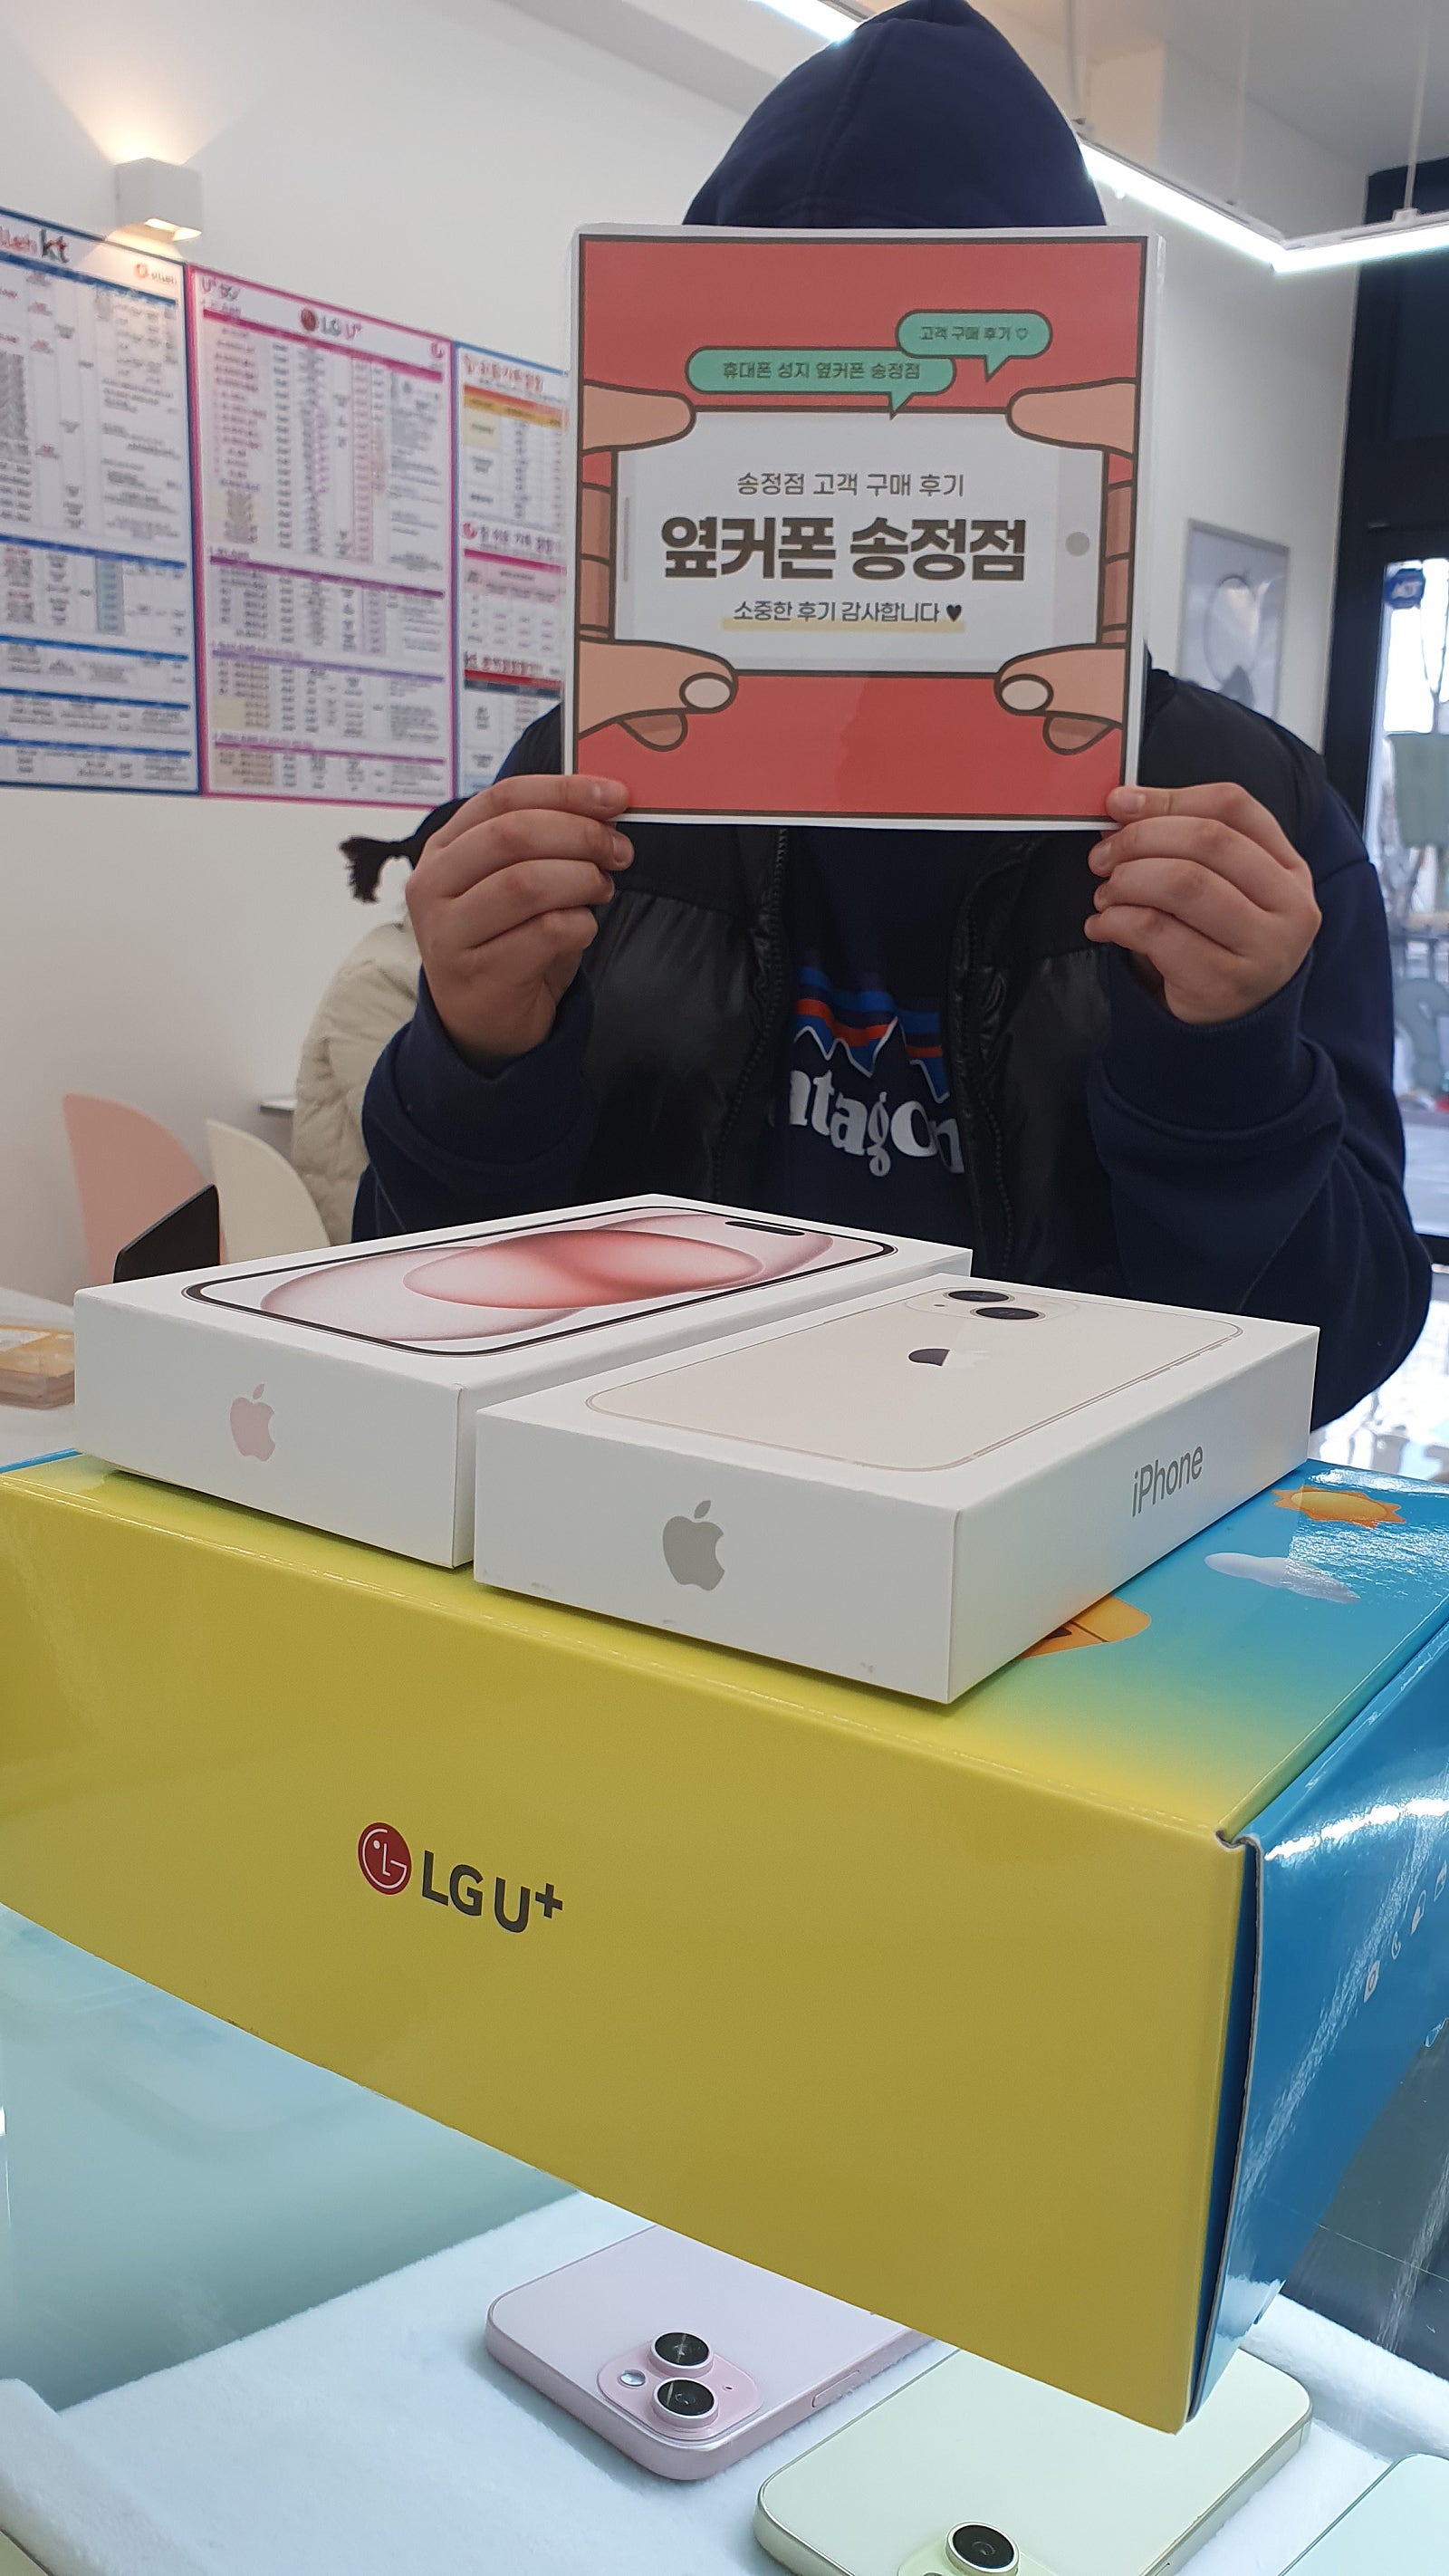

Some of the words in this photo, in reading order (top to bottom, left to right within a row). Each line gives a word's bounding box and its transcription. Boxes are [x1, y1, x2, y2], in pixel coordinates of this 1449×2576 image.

[41, 228, 70, 264] kt
[919, 326, 947, 341] 고객
[951, 326, 979, 341] 구매
[984, 326, 1011, 341] 후기
[723, 360, 772, 380] 휴대폰
[777, 361, 810, 380] 성지
[815, 361, 865, 380] 옆커폰
[870, 361, 921, 380] 송정점
[736, 472, 806, 496] 송정점
[813, 473, 859, 496] 고객
[866, 473, 911, 497] 구매
[918, 474, 965, 497] 후기
[660, 515, 837, 580] 옆커폰
[849, 516, 1027, 582] 송정점
[733, 601, 793, 622] 소중한
[796, 601, 837, 623] 후기
[840, 601, 940, 623] 감사합니다
[1132, 1446, 1204, 1518] iPhone
[421, 1850, 484, 1917] LG
[494, 1876, 563, 1934] U+
